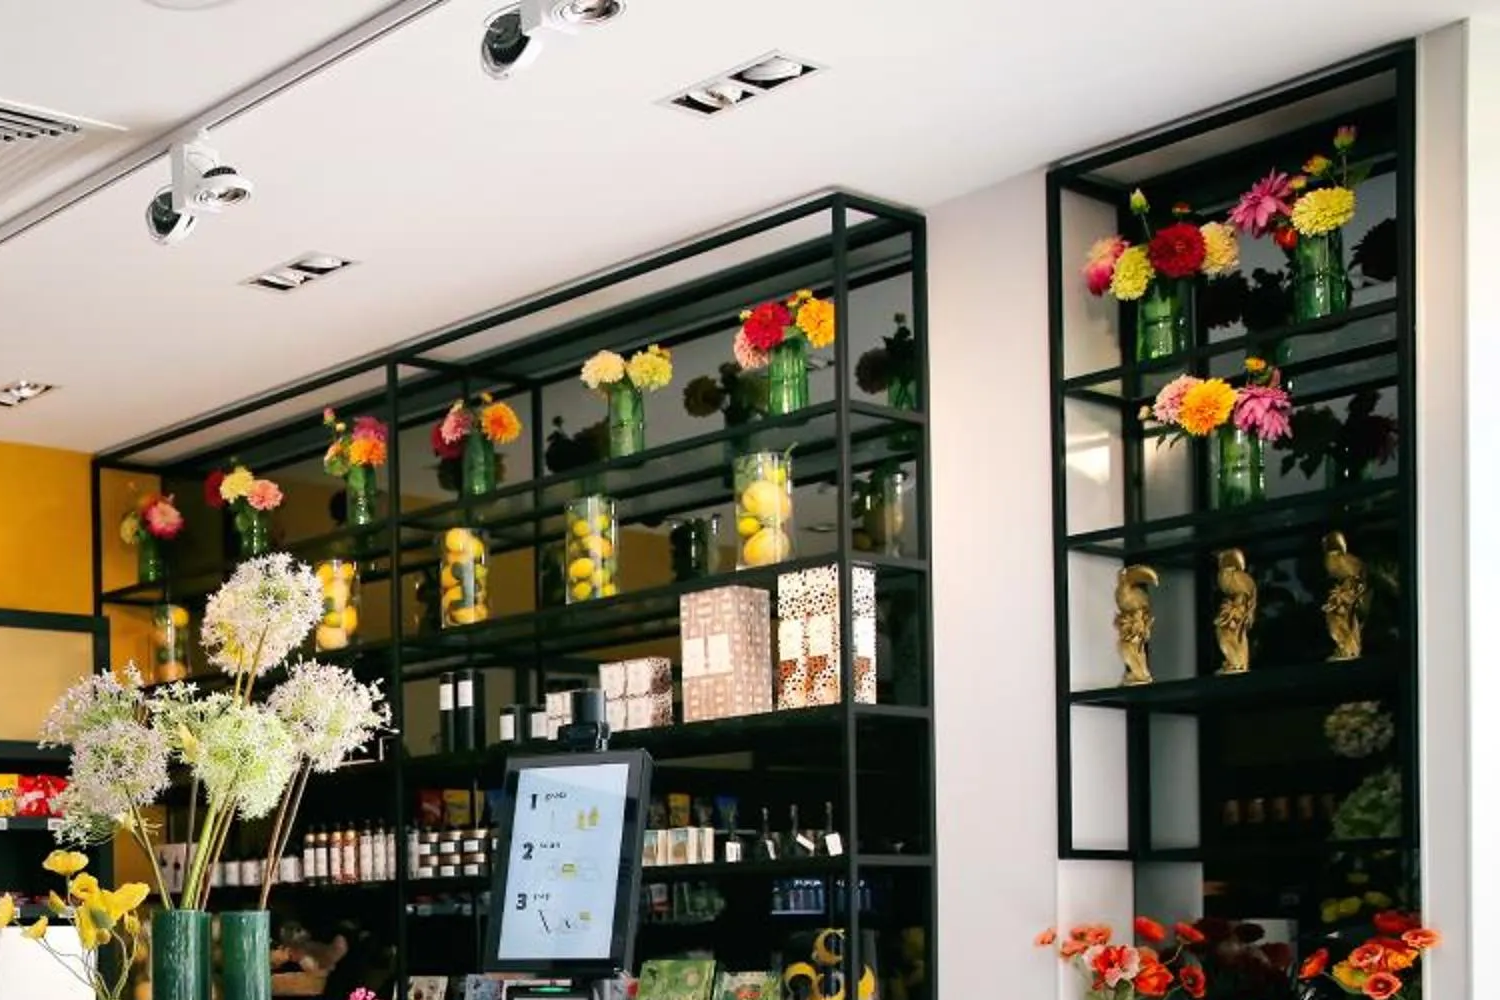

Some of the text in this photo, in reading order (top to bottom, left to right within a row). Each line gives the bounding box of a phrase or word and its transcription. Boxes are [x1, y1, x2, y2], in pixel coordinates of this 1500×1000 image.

[531, 793, 538, 811] 1
[522, 842, 534, 860] 2
[516, 893, 528, 911] 3
